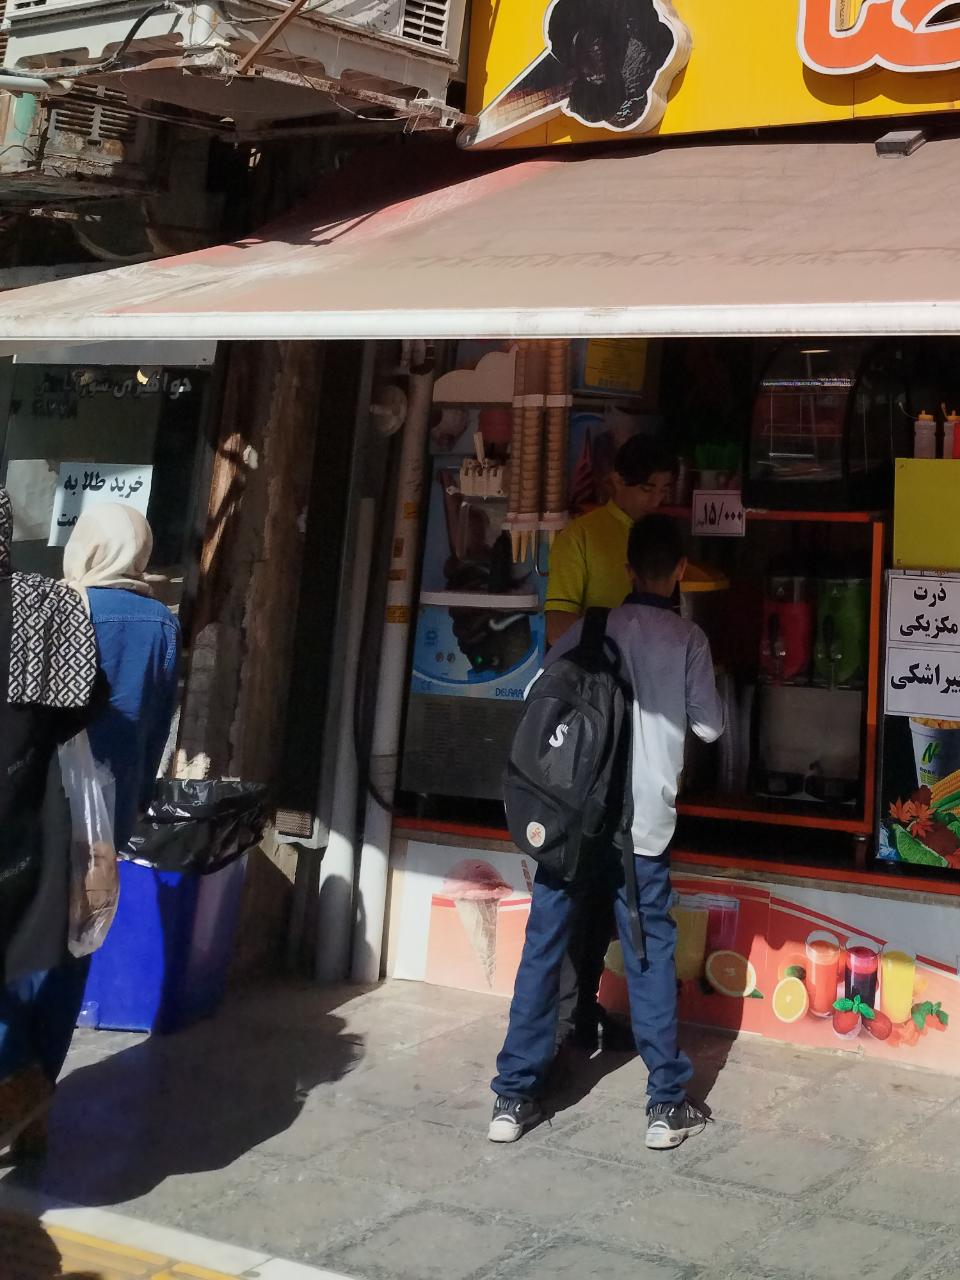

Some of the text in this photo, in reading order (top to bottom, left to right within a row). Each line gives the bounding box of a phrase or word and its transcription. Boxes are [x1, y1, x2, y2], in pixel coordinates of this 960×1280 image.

[64, 471, 143, 499] خرید طلا به
[914, 583, 947, 606] ذرت
[900, 614, 959, 638] مکزیکی
